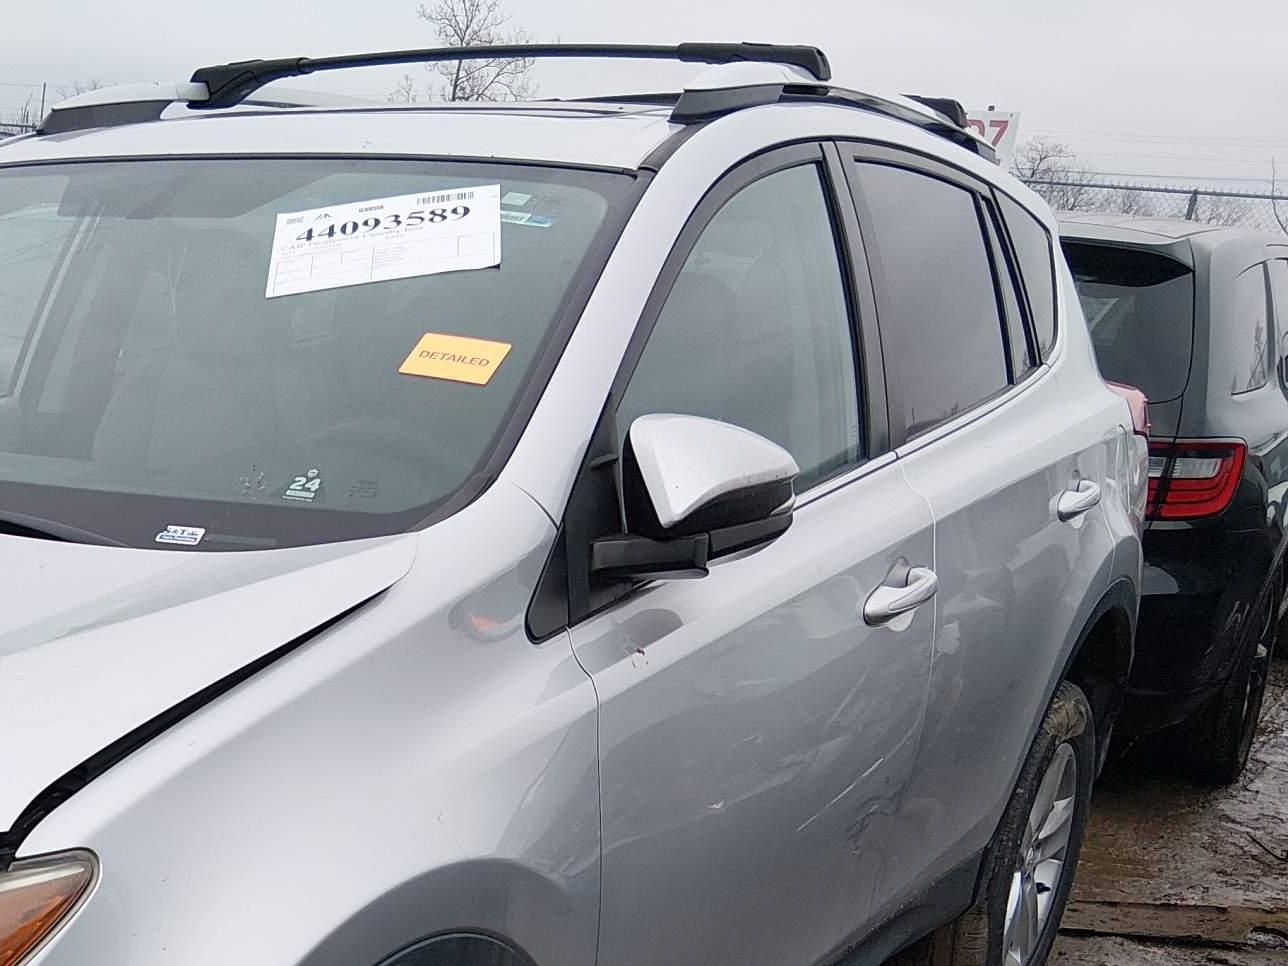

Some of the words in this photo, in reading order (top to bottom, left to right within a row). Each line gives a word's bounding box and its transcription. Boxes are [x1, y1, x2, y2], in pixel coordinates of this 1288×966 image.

[295, 206, 471, 241] 44093589
[418, 350, 490, 367] DETAILED
[289, 476, 321, 491] 24
